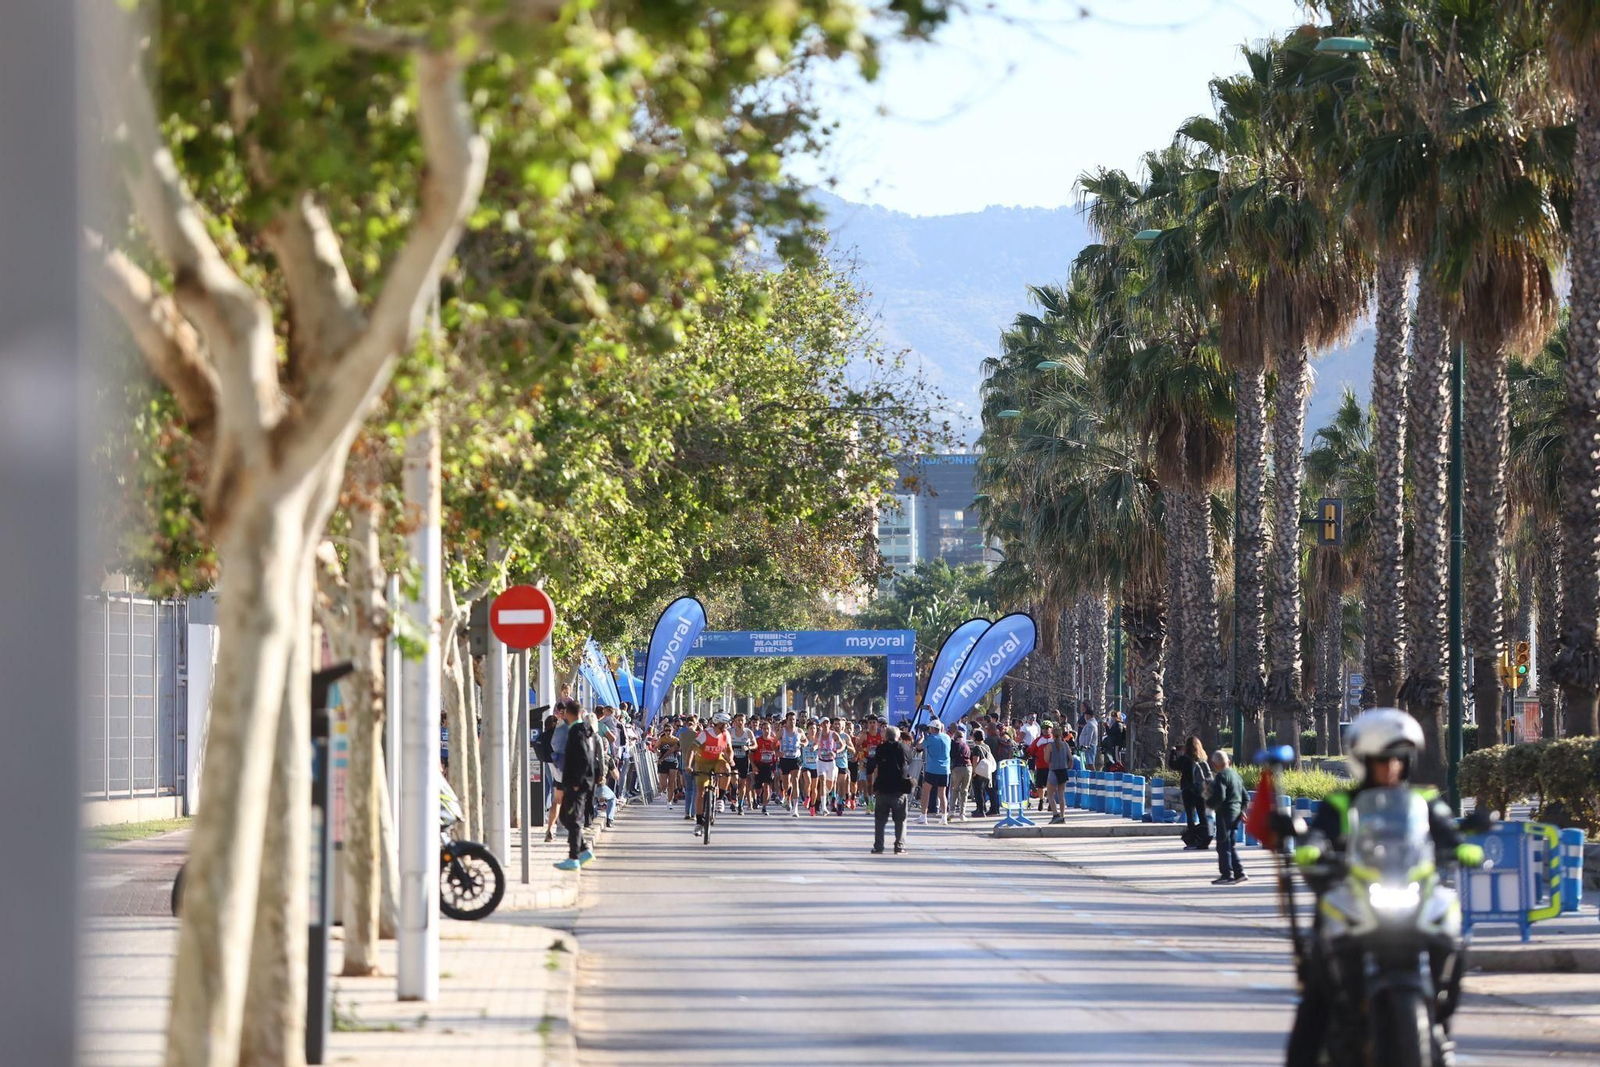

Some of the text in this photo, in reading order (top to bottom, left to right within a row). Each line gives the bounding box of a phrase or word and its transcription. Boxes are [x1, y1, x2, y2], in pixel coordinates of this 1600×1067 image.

[651, 616, 692, 689] mayoral
[846, 634, 904, 649] mayoral
[959, 631, 1021, 699] mayoral
[531, 729, 538, 740] P
